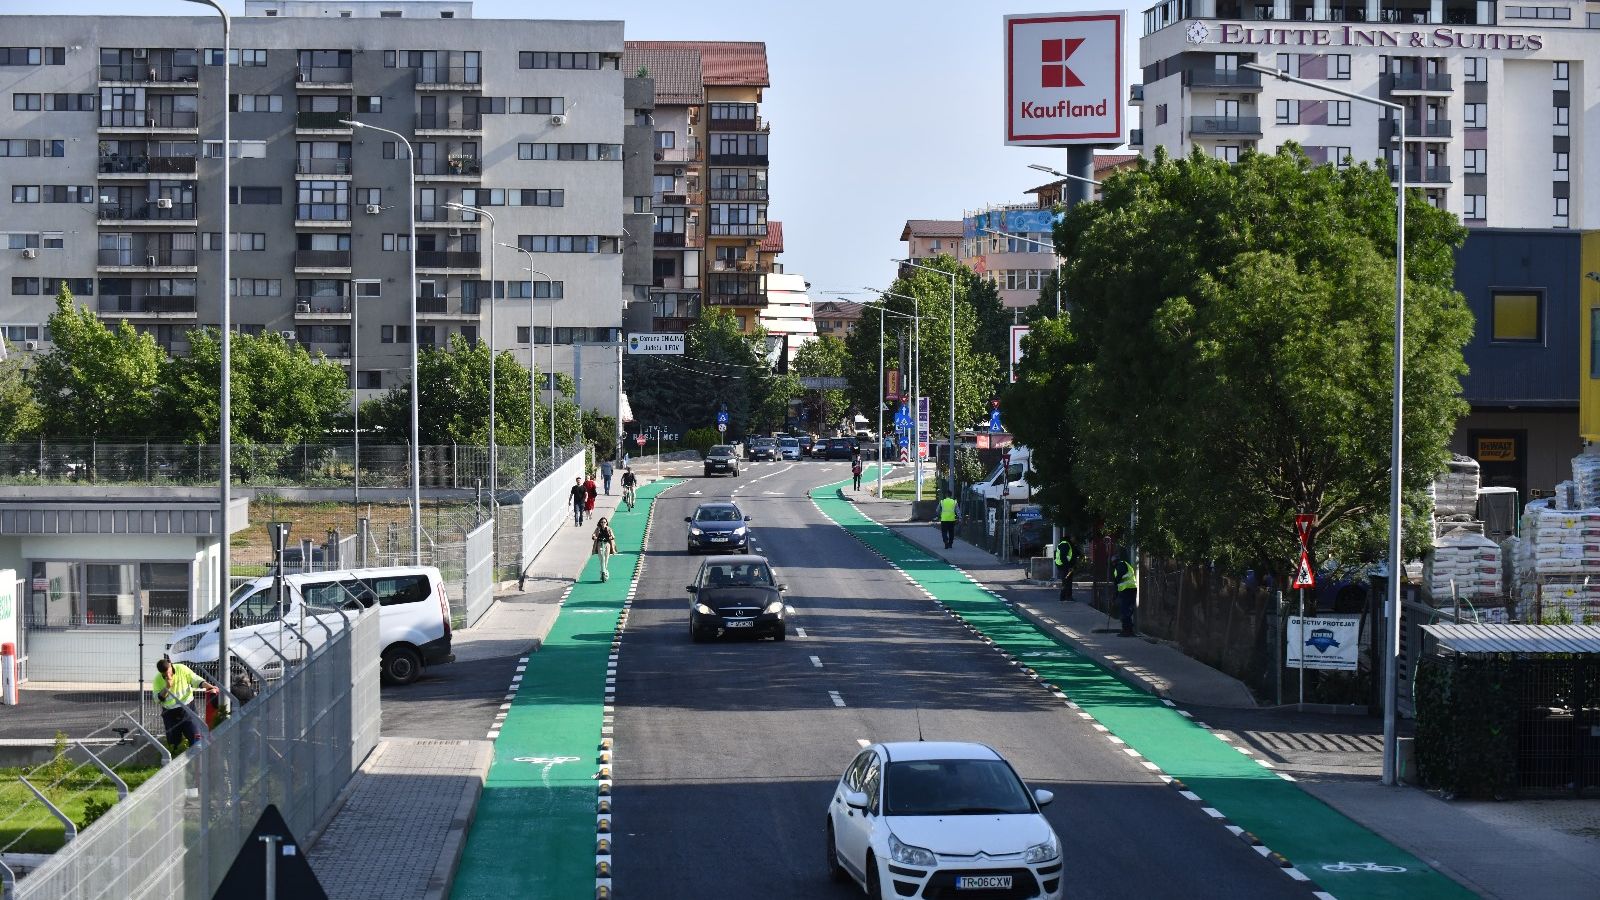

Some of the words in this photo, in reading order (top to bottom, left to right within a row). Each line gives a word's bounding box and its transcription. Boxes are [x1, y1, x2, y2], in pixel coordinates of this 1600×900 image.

[1342, 25, 1401, 47] INN
[1409, 31, 1425, 48] &
[1433, 27, 1543, 51] SUITES
[1021, 99, 1107, 118] Kaufland
